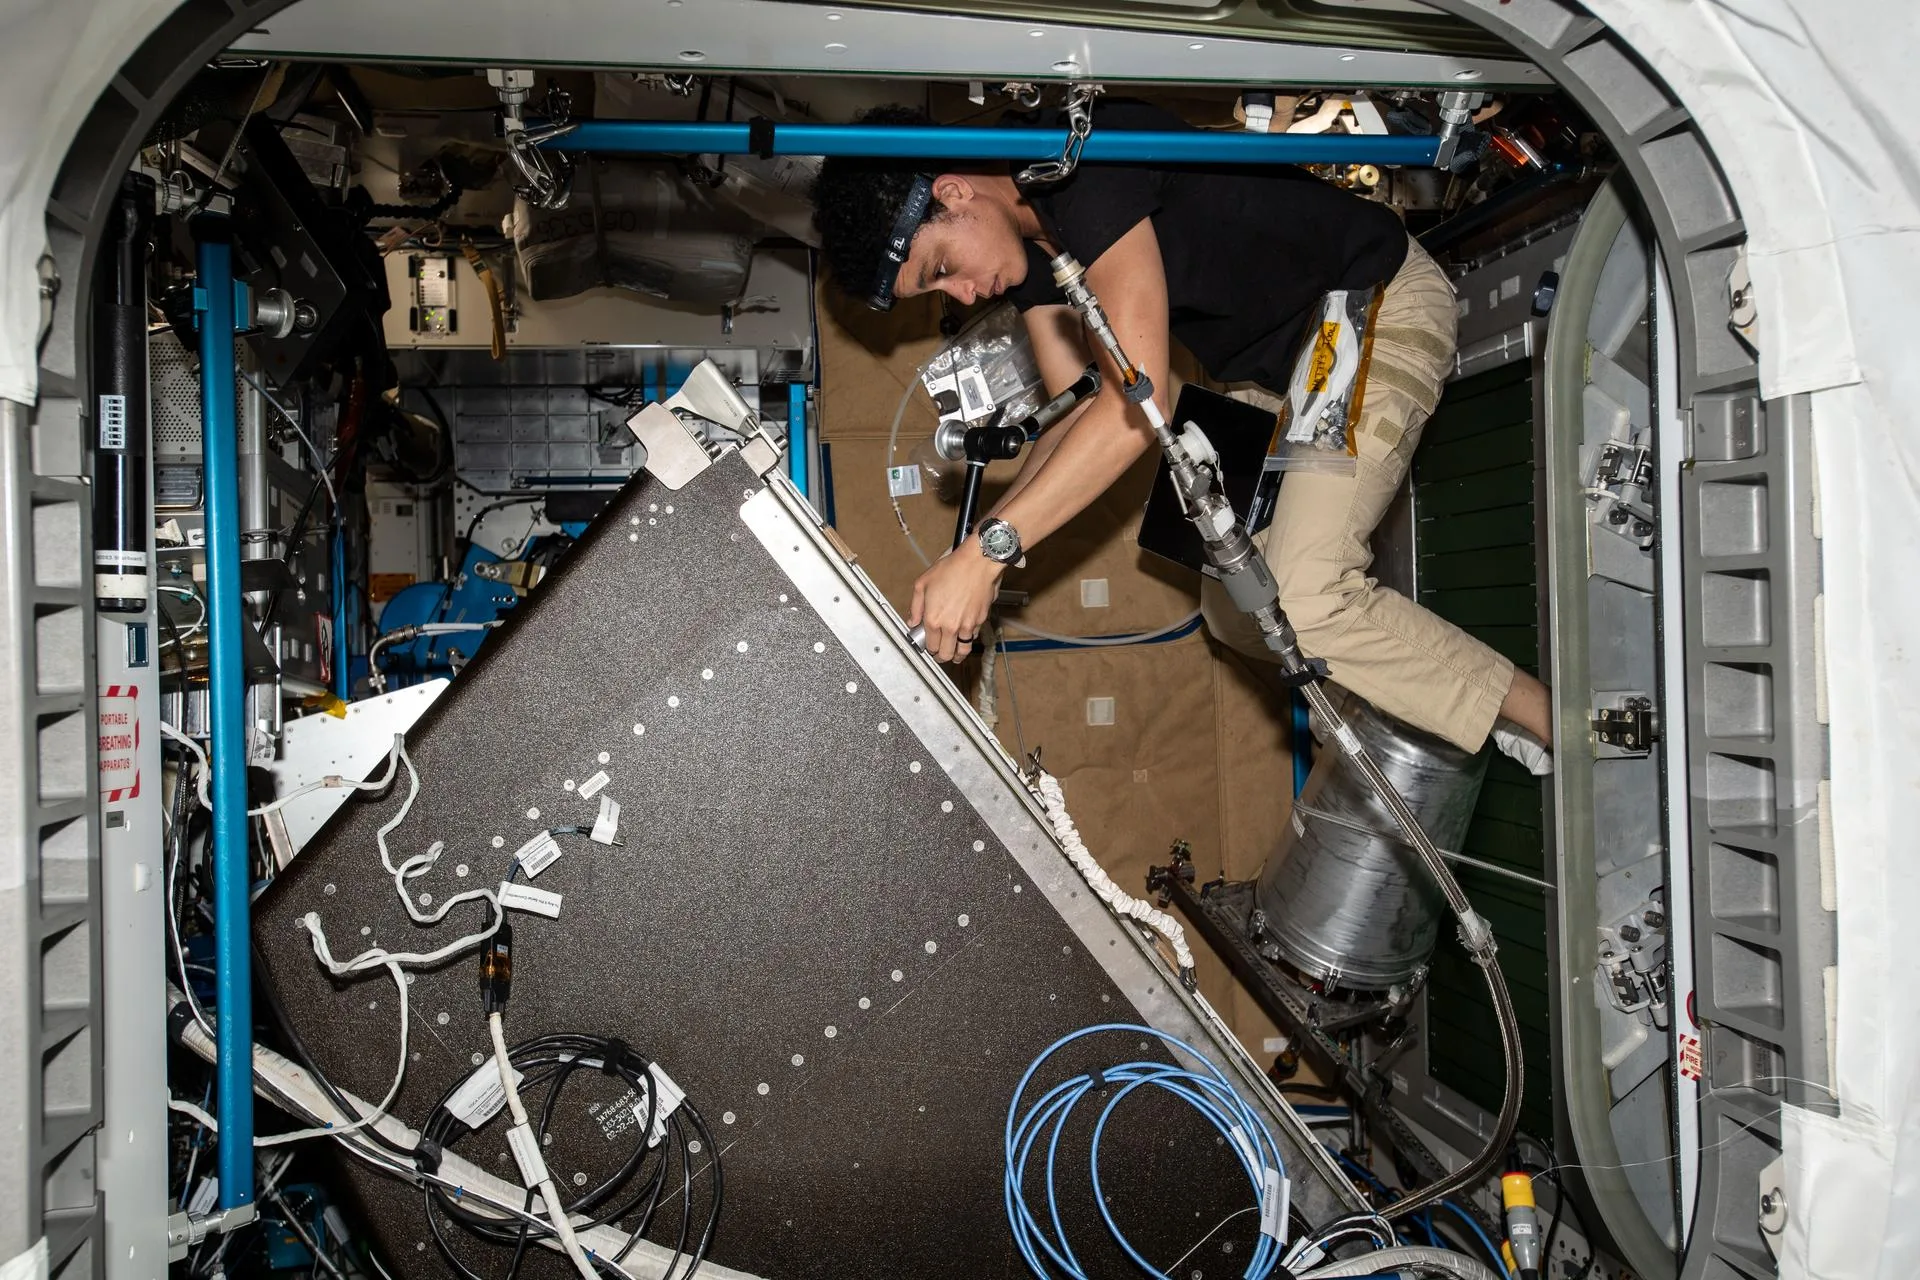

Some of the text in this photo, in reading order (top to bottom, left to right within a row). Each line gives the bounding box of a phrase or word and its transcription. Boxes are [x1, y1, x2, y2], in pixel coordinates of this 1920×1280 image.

[909, 187, 928, 218] TIKKA
[100, 713, 129, 725] PORTABLE
[98, 734, 132, 751] BREATHING
[99, 758, 131, 773] APPARATUS
[1685, 1053, 1699, 1066] FIRE
